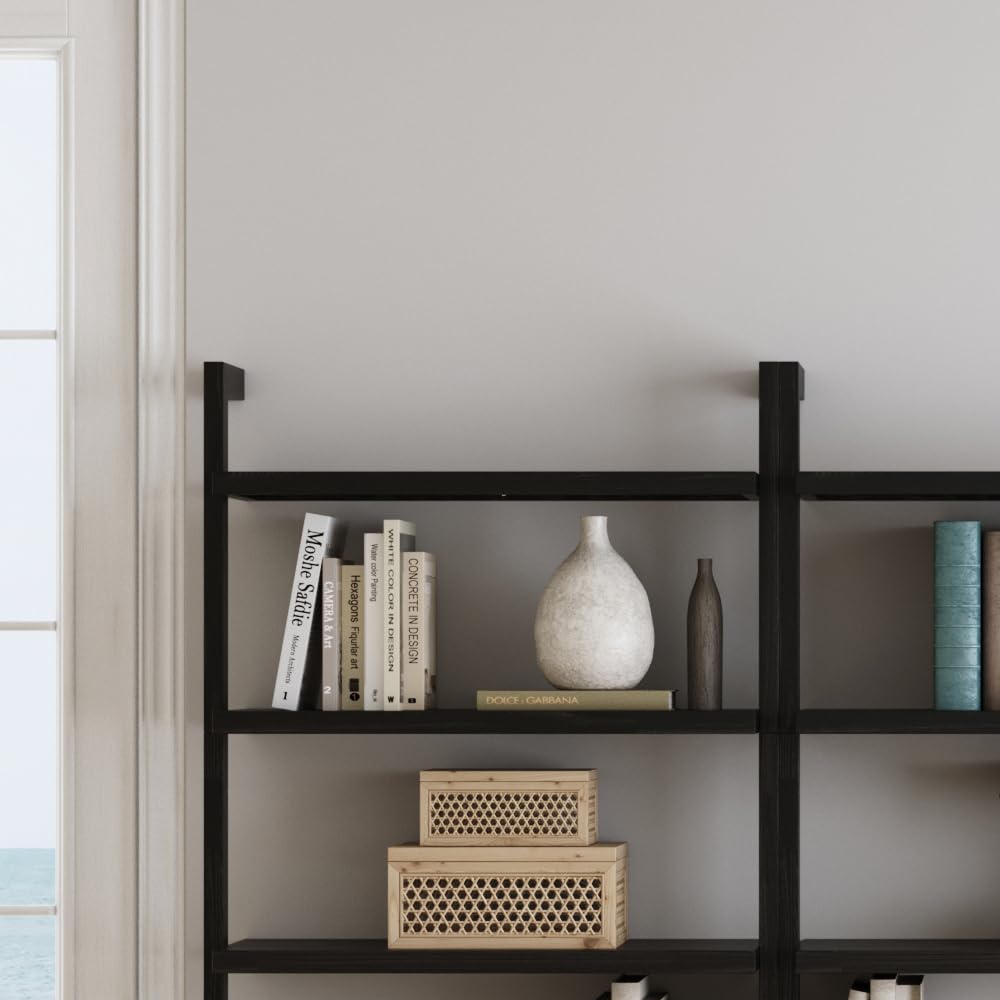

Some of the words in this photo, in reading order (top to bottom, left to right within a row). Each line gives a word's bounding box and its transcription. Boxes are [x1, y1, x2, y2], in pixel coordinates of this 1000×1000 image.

[300, 529, 324, 579] Moshe
[370, 543, 378, 561] Water
[371, 562, 379, 577] color
[369, 578, 378, 602] Painting
[408, 558, 419, 613] CONCRETE
[291, 582, 315, 627] Safdie
[323, 581, 334, 622] CAMERA
[348, 575, 361, 623] Hexagons
[388, 613, 395, 625] IN
[408, 614, 419, 625] IN
[323, 624, 334, 634] &
[323, 635, 334, 648] Art
[408, 626, 419, 664] DESIGN
[350, 658, 359, 669] art
[282, 691, 288, 700] 1
[323, 686, 332, 694] 2
[387, 695, 395, 703] W
[486, 696, 520, 705] DOLCE
[526, 696, 579, 705] GABBANA
